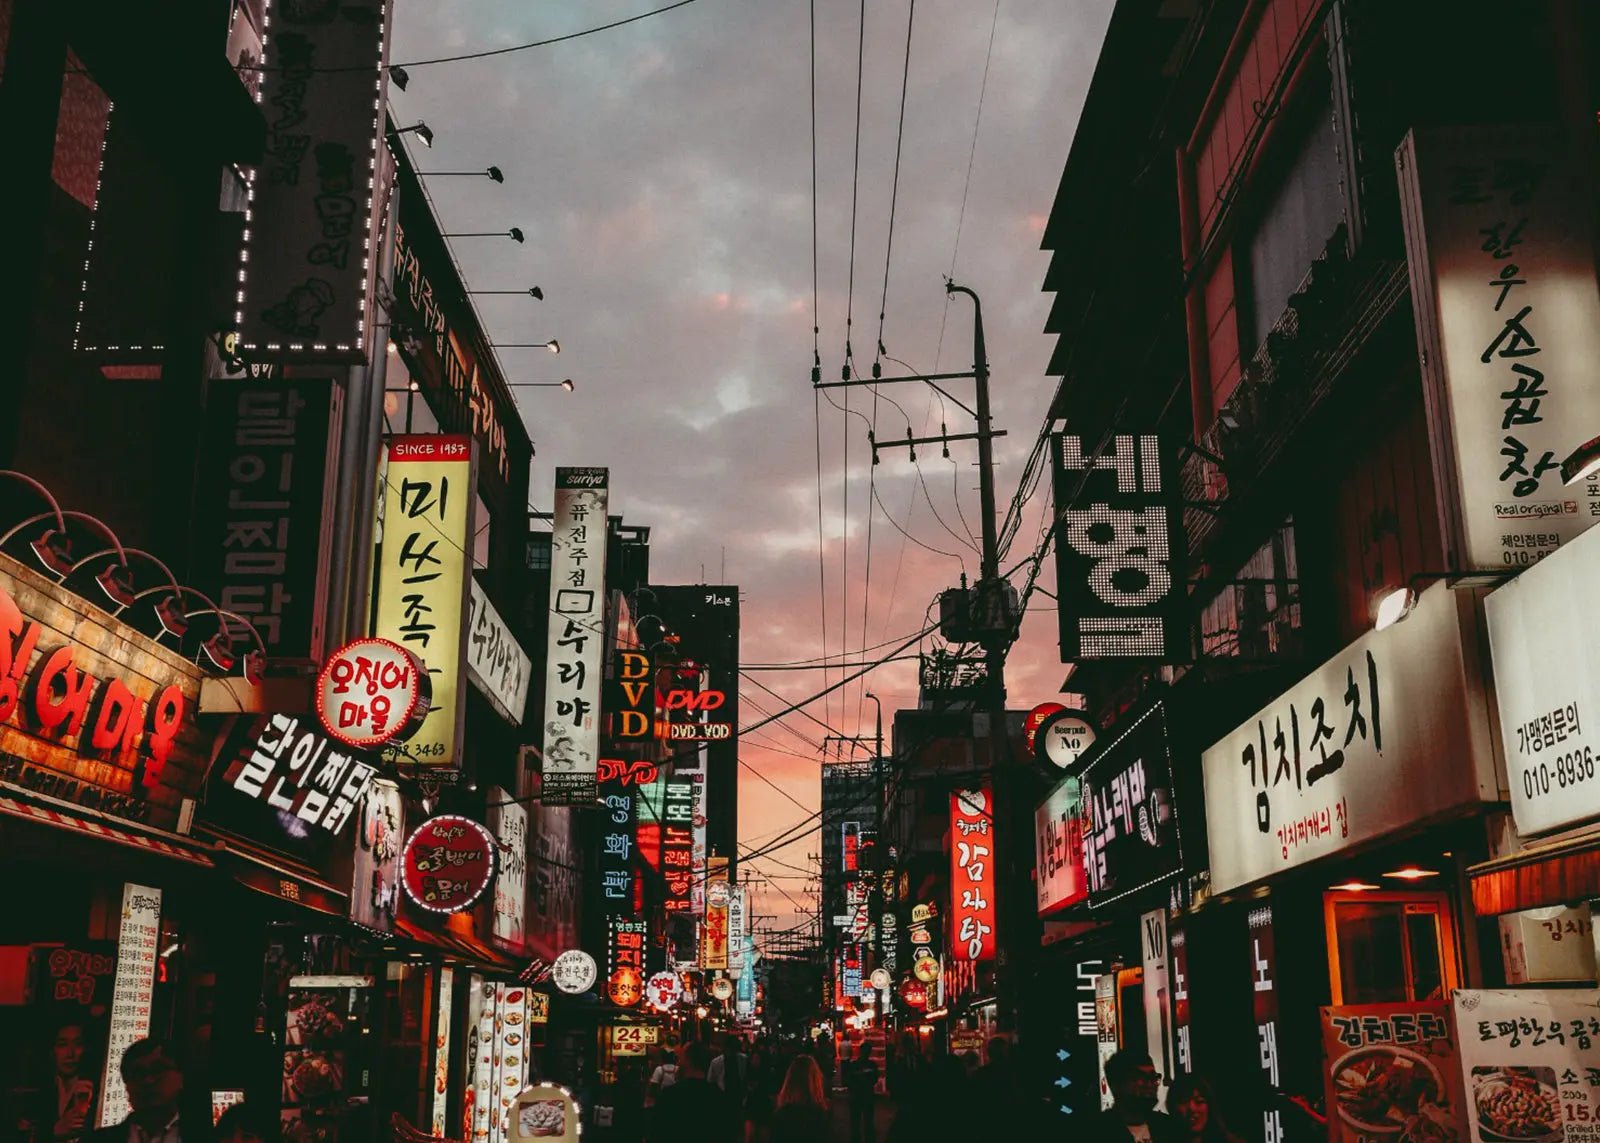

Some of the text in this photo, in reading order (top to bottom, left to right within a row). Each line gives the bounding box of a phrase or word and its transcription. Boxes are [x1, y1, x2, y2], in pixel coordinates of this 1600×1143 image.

[396, 443, 467, 456] SINCE 1987
[566, 472, 604, 487] suriya
[568, 503, 590, 588] 퓨전주점
[1501, 534, 1561, 548] 체인점문의
[472, 599, 513, 692] 수리야
[330, 656, 409, 695] 오징어
[556, 619, 590, 727] 수리야
[619, 652, 650, 737] DVD
[665, 689, 726, 711] DVD
[338, 695, 391, 736] 마을
[671, 724, 697, 738] DVD
[1517, 701, 1582, 756] 가맹점문의
[1242, 649, 1382, 834] 김치조치
[597, 759, 658, 786] DVD
[1277, 796, 1348, 860] 김치찌개의 집
[957, 842, 991, 959] 감자탕
[617, 1028, 641, 1042] 24
[1560, 1068, 1579, 1085] 소
